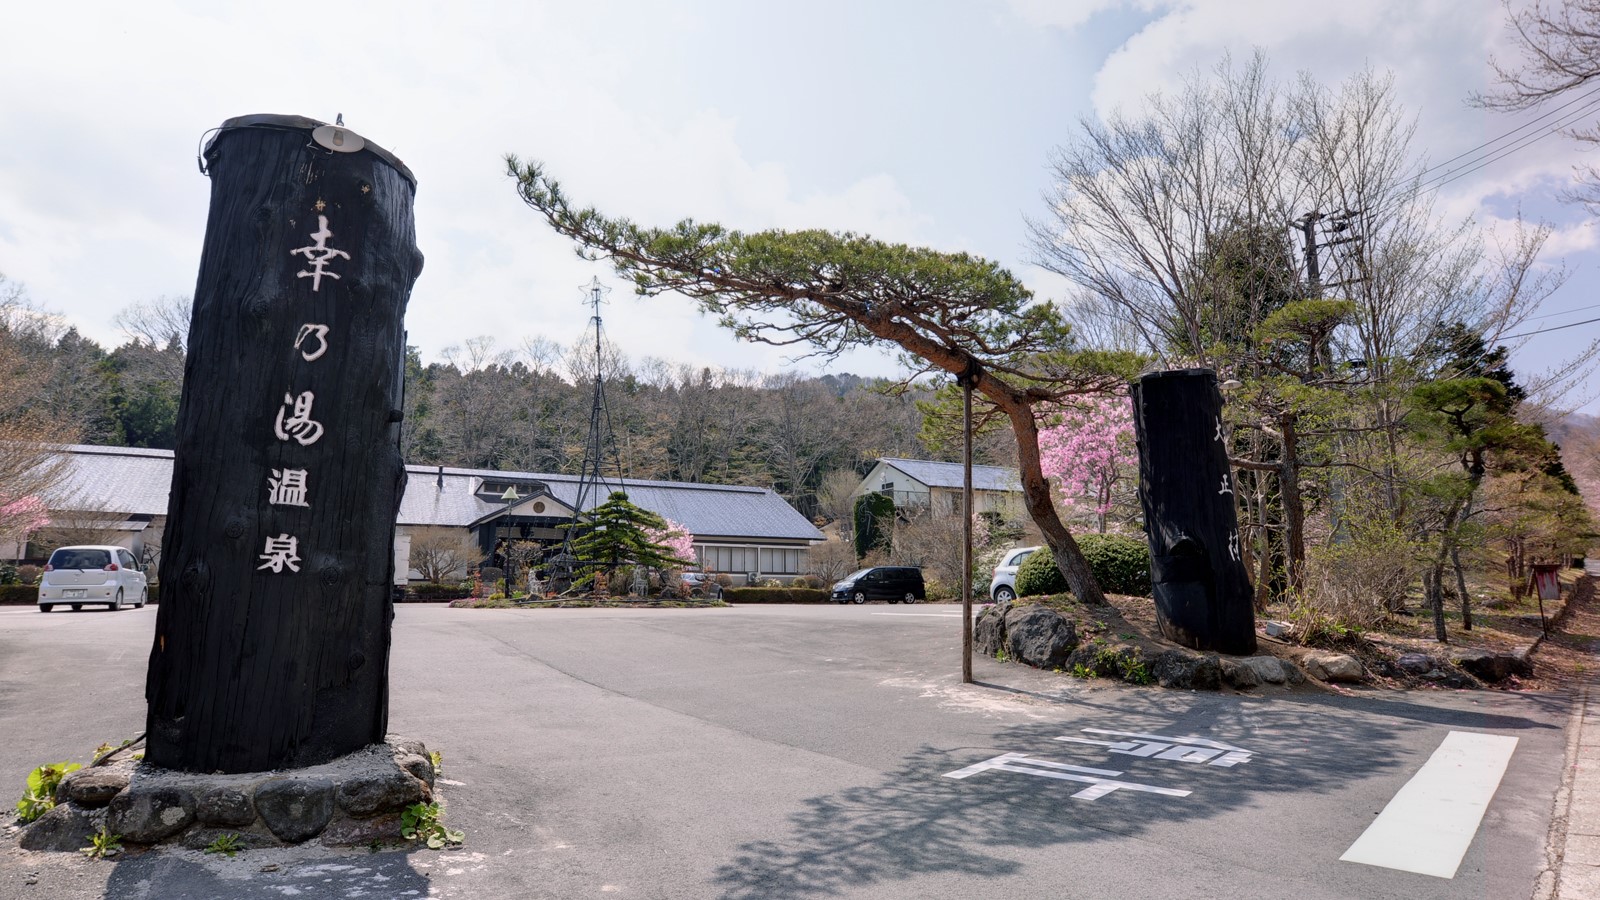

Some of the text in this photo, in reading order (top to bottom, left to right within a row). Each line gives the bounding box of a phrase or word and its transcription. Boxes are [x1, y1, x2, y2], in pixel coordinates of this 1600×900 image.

[257, 215, 351, 574] 幸乃湯温泉
